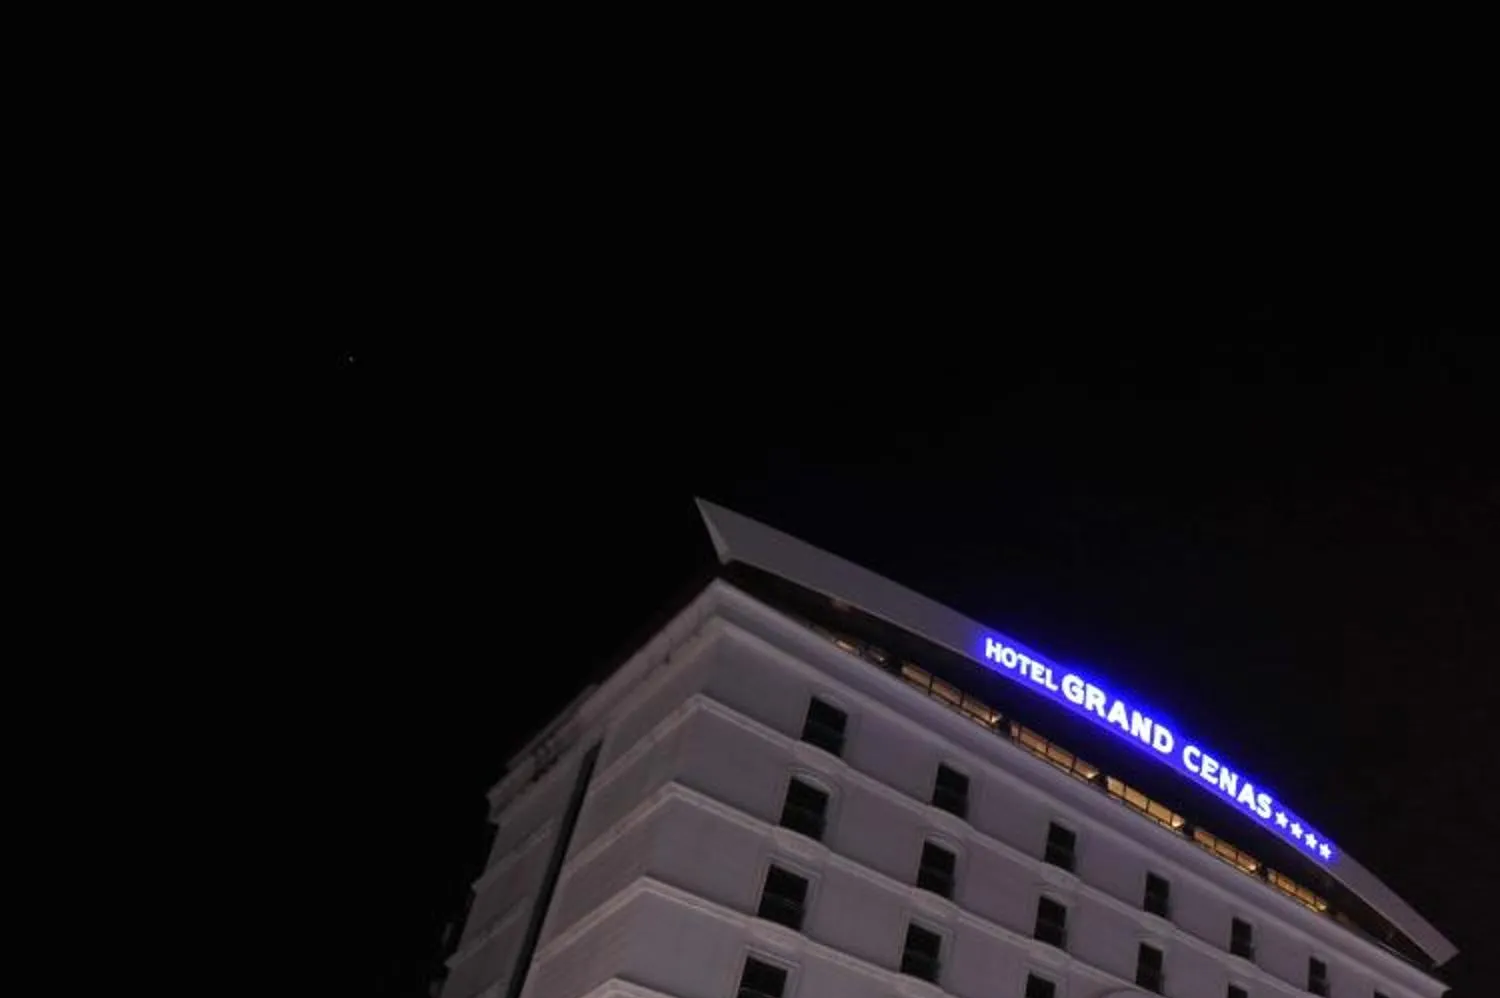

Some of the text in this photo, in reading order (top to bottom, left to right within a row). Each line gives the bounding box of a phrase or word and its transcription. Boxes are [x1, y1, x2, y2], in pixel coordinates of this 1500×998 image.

[985, 637, 1274, 820] HOTEL GRAND CENAS
